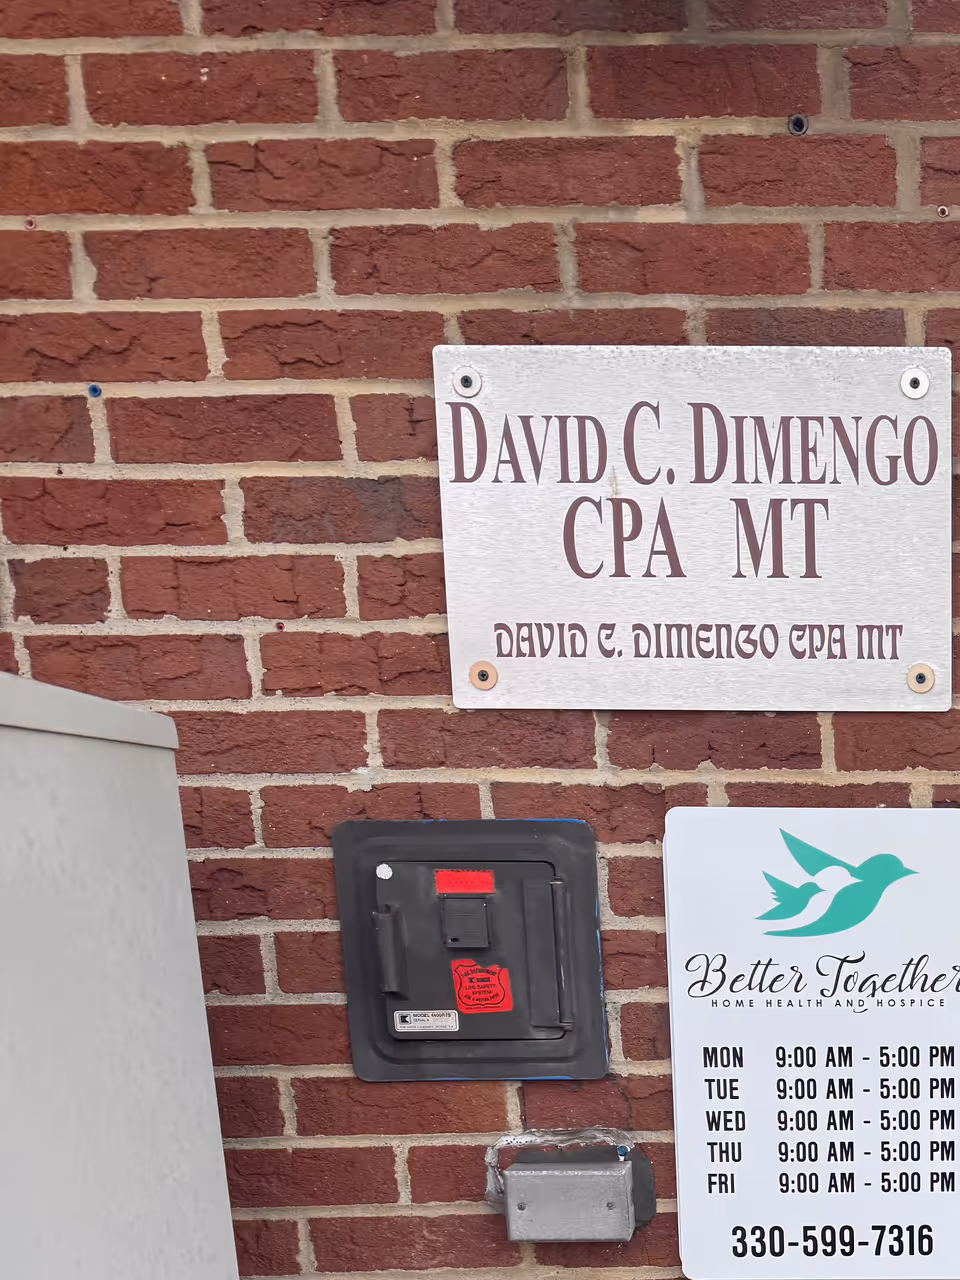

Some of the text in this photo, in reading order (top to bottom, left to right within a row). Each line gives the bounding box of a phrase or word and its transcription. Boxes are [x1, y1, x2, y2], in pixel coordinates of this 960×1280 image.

[444, 400, 939, 486] DAVID C. DIMENGO
[562, 495, 830, 579] CPA MT
[493, 622, 588, 659] DAVID
[597, 622, 623, 659] C.
[788, 623, 847, 660] CPA
[855, 624, 904, 661] MT
[684, 953, 808, 998] Better
[711, 998, 946, 1008] HOME HEALTH AND HOSPICE
[702, 1046, 744, 1068] MON
[775, 1045, 817, 1068] 9:00
[825, 1045, 853, 1068] AM
[879, 1045, 920, 1068] 5:00
[929, 1045, 955, 1068] PM
[704, 1078, 740, 1100] TUE
[776, 1077, 817, 1100] 9:00
[825, 1077, 854, 1100] AM
[879, 1077, 921, 1100] 5:00
[929, 1077, 955, 1100] PM
[705, 1110, 746, 1132] WED
[777, 1109, 818, 1132] 9:00
[826, 1109, 854, 1132] AM
[880, 1109, 921, 1132] 5:00
[929, 1109, 955, 1132] PM
[706, 1141, 742, 1163] THU
[778, 1140, 819, 1163] 9:00
[827, 1140, 855, 1163] AM
[880, 1140, 921, 1163] 5:00
[929, 1140, 955, 1163] PM
[707, 1172, 735, 1194] FRI
[778, 1171, 819, 1194] 9:00
[827, 1171, 855, 1194] AM
[881, 1171, 921, 1194] 5:00
[930, 1171, 955, 1194] PM
[731, 1224, 934, 1258] 330-599-7316
